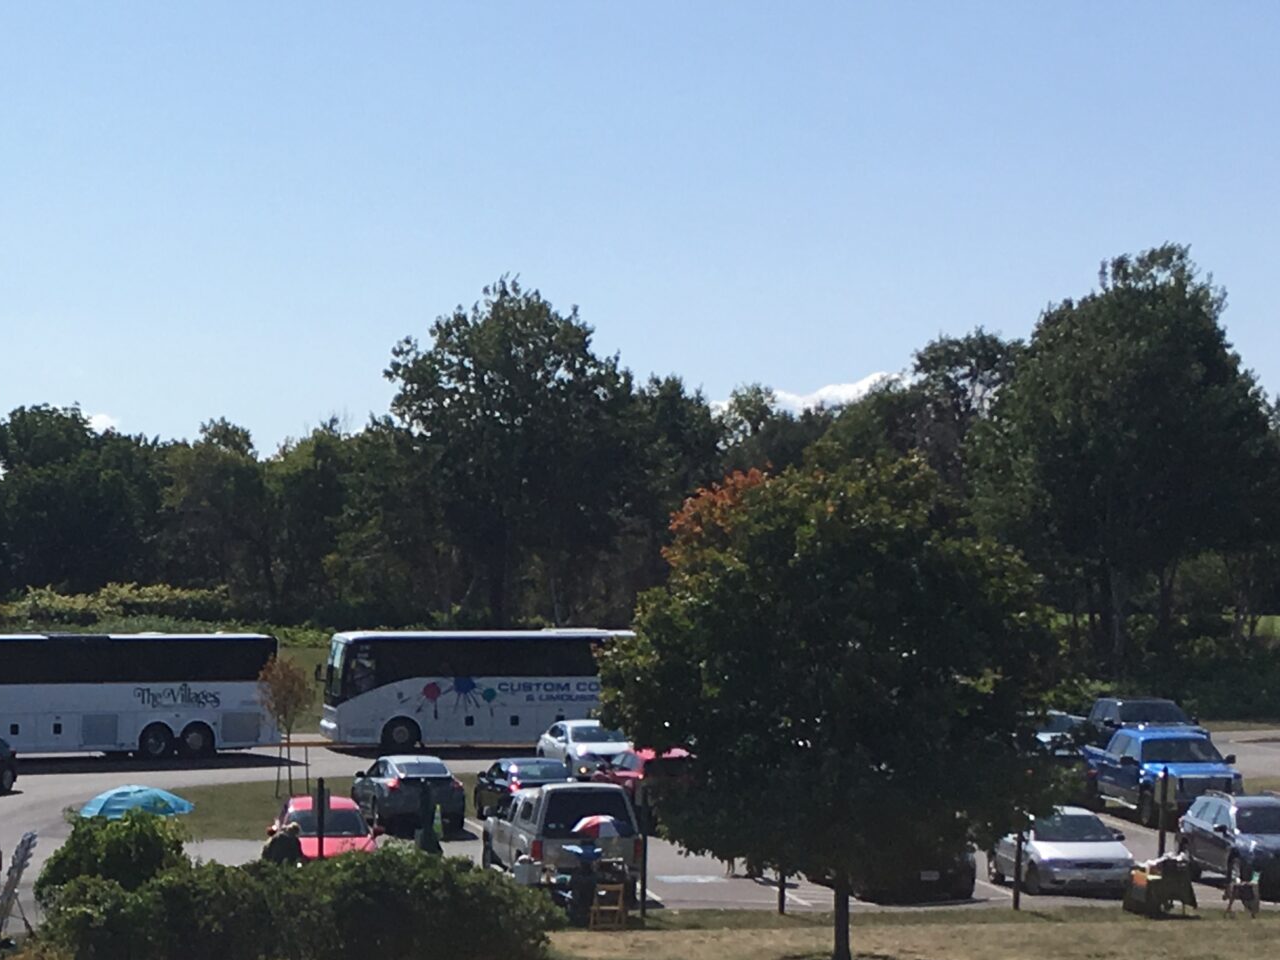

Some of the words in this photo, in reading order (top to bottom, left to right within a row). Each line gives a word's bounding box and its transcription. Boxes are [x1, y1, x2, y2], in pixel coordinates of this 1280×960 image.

[133, 686, 162, 708] The
[162, 682, 221, 708] Villages
[497, 681, 571, 692] CUSTOM
[575, 681, 600, 692] CO
